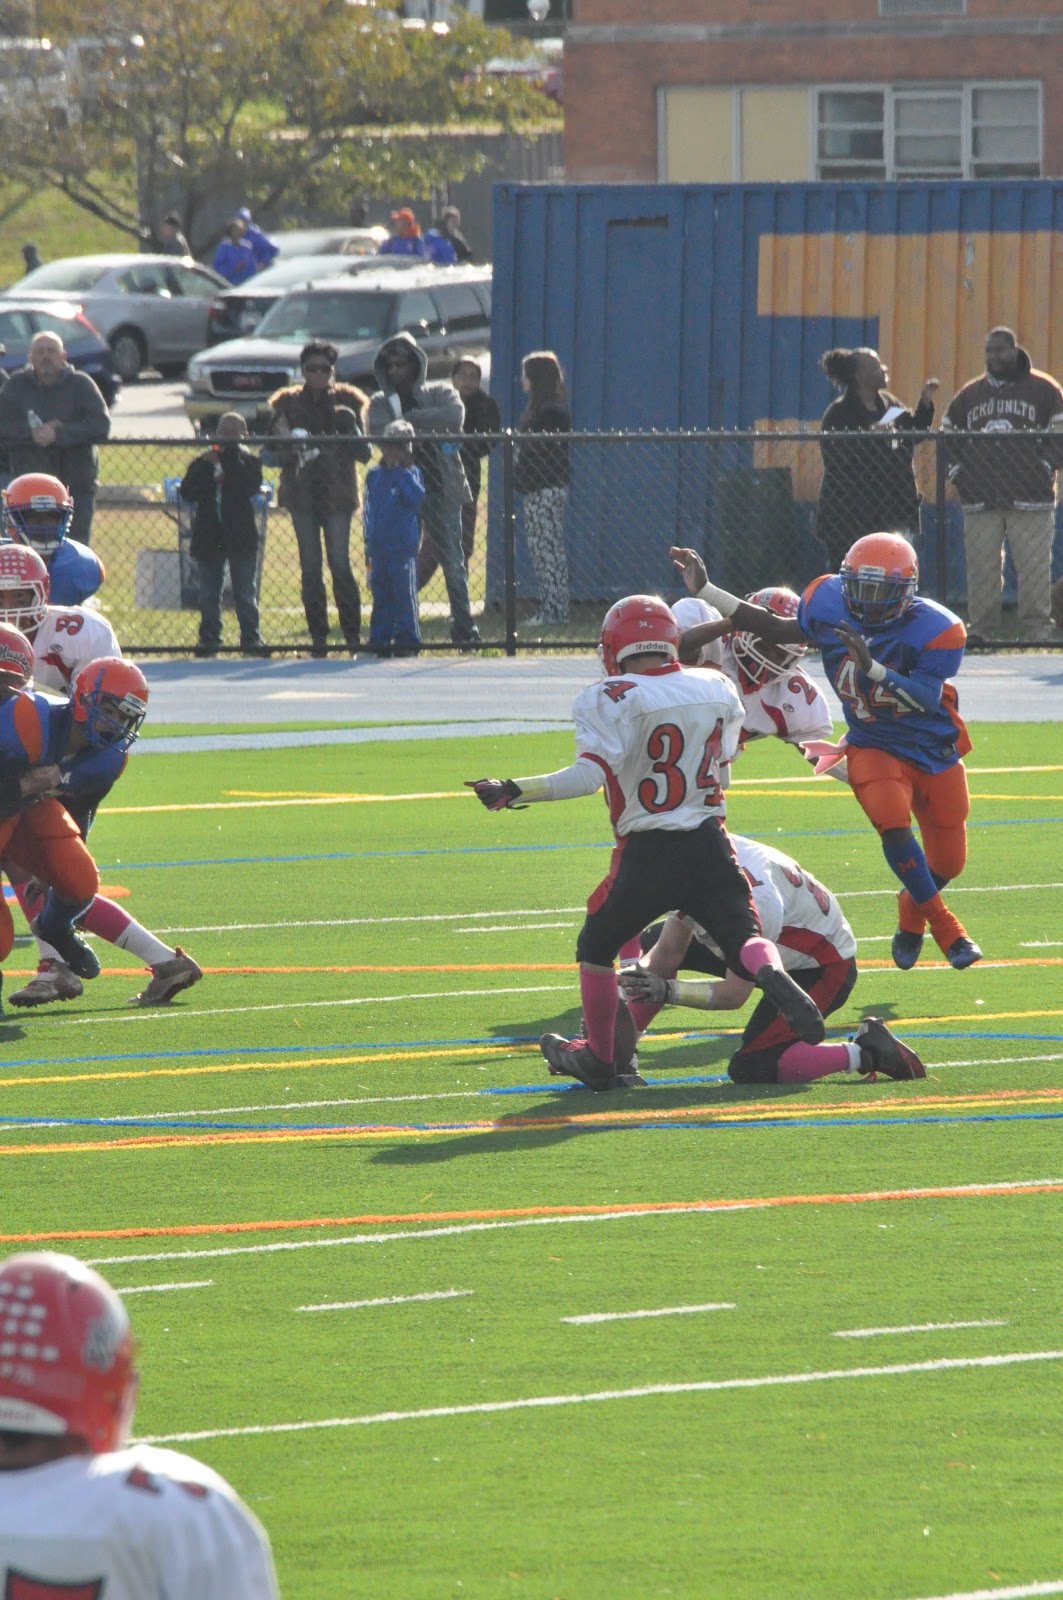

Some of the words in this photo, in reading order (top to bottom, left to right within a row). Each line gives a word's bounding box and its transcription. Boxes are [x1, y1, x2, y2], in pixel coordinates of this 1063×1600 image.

[603, 680, 638, 703] 4
[788, 675, 818, 706] 2
[638, 717, 726, 814] 34
